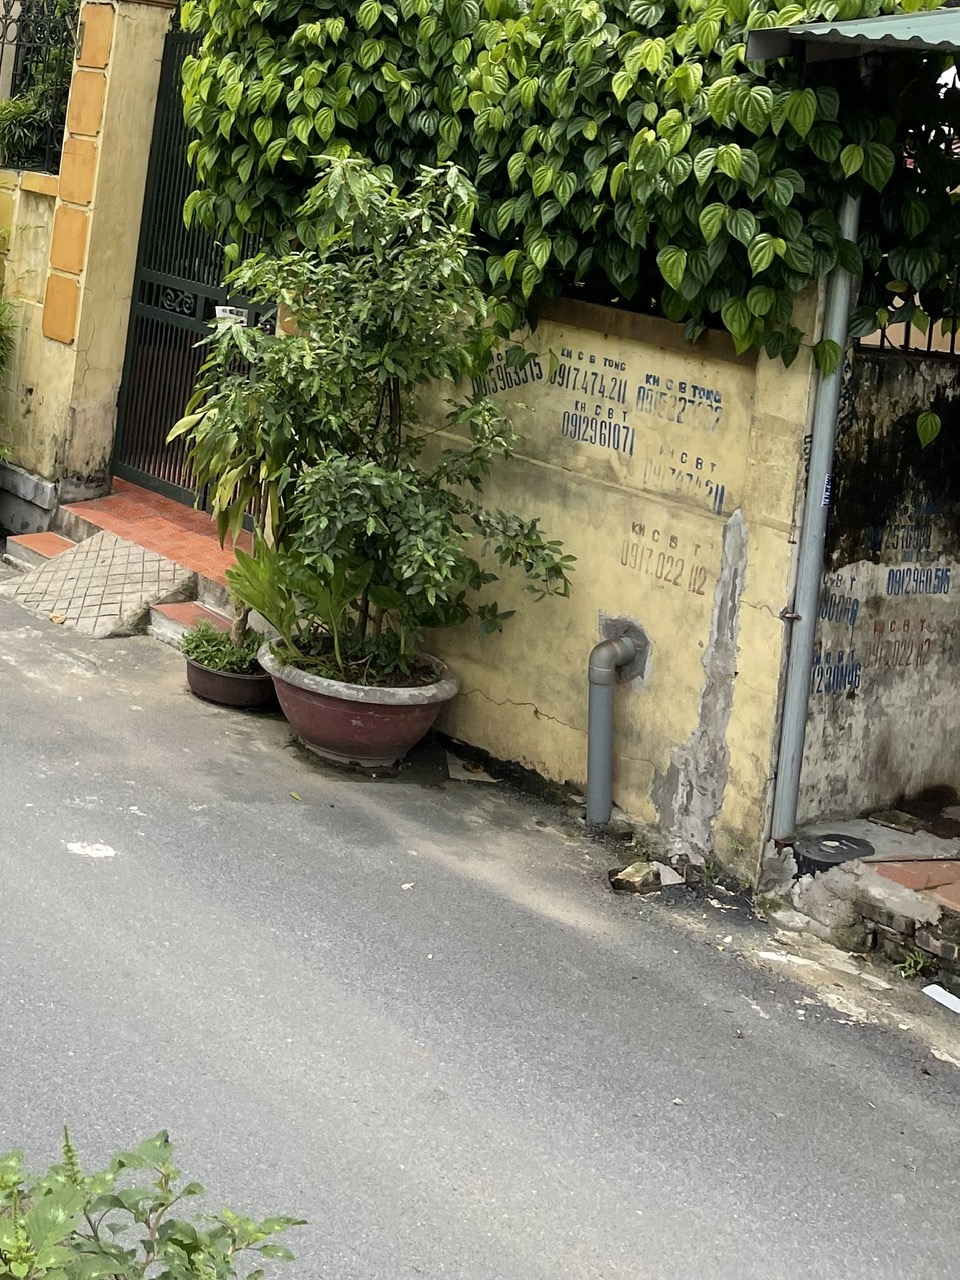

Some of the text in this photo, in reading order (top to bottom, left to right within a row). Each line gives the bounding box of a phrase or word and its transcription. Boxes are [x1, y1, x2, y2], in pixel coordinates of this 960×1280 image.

[603, 358, 627, 372] TONG
[645, 373, 660, 387] KH
[678, 381, 687, 394] B
[574, 400, 586, 413] KH
[607, 408, 614, 419] B
[622, 411, 628, 422] T
[561, 411, 635, 457] 0912961071
[680, 452, 688, 464] C
[695, 457, 704, 470] B
[710, 463, 717, 473] T
[631, 521, 646, 537] KH
[652, 529, 660, 543] C
